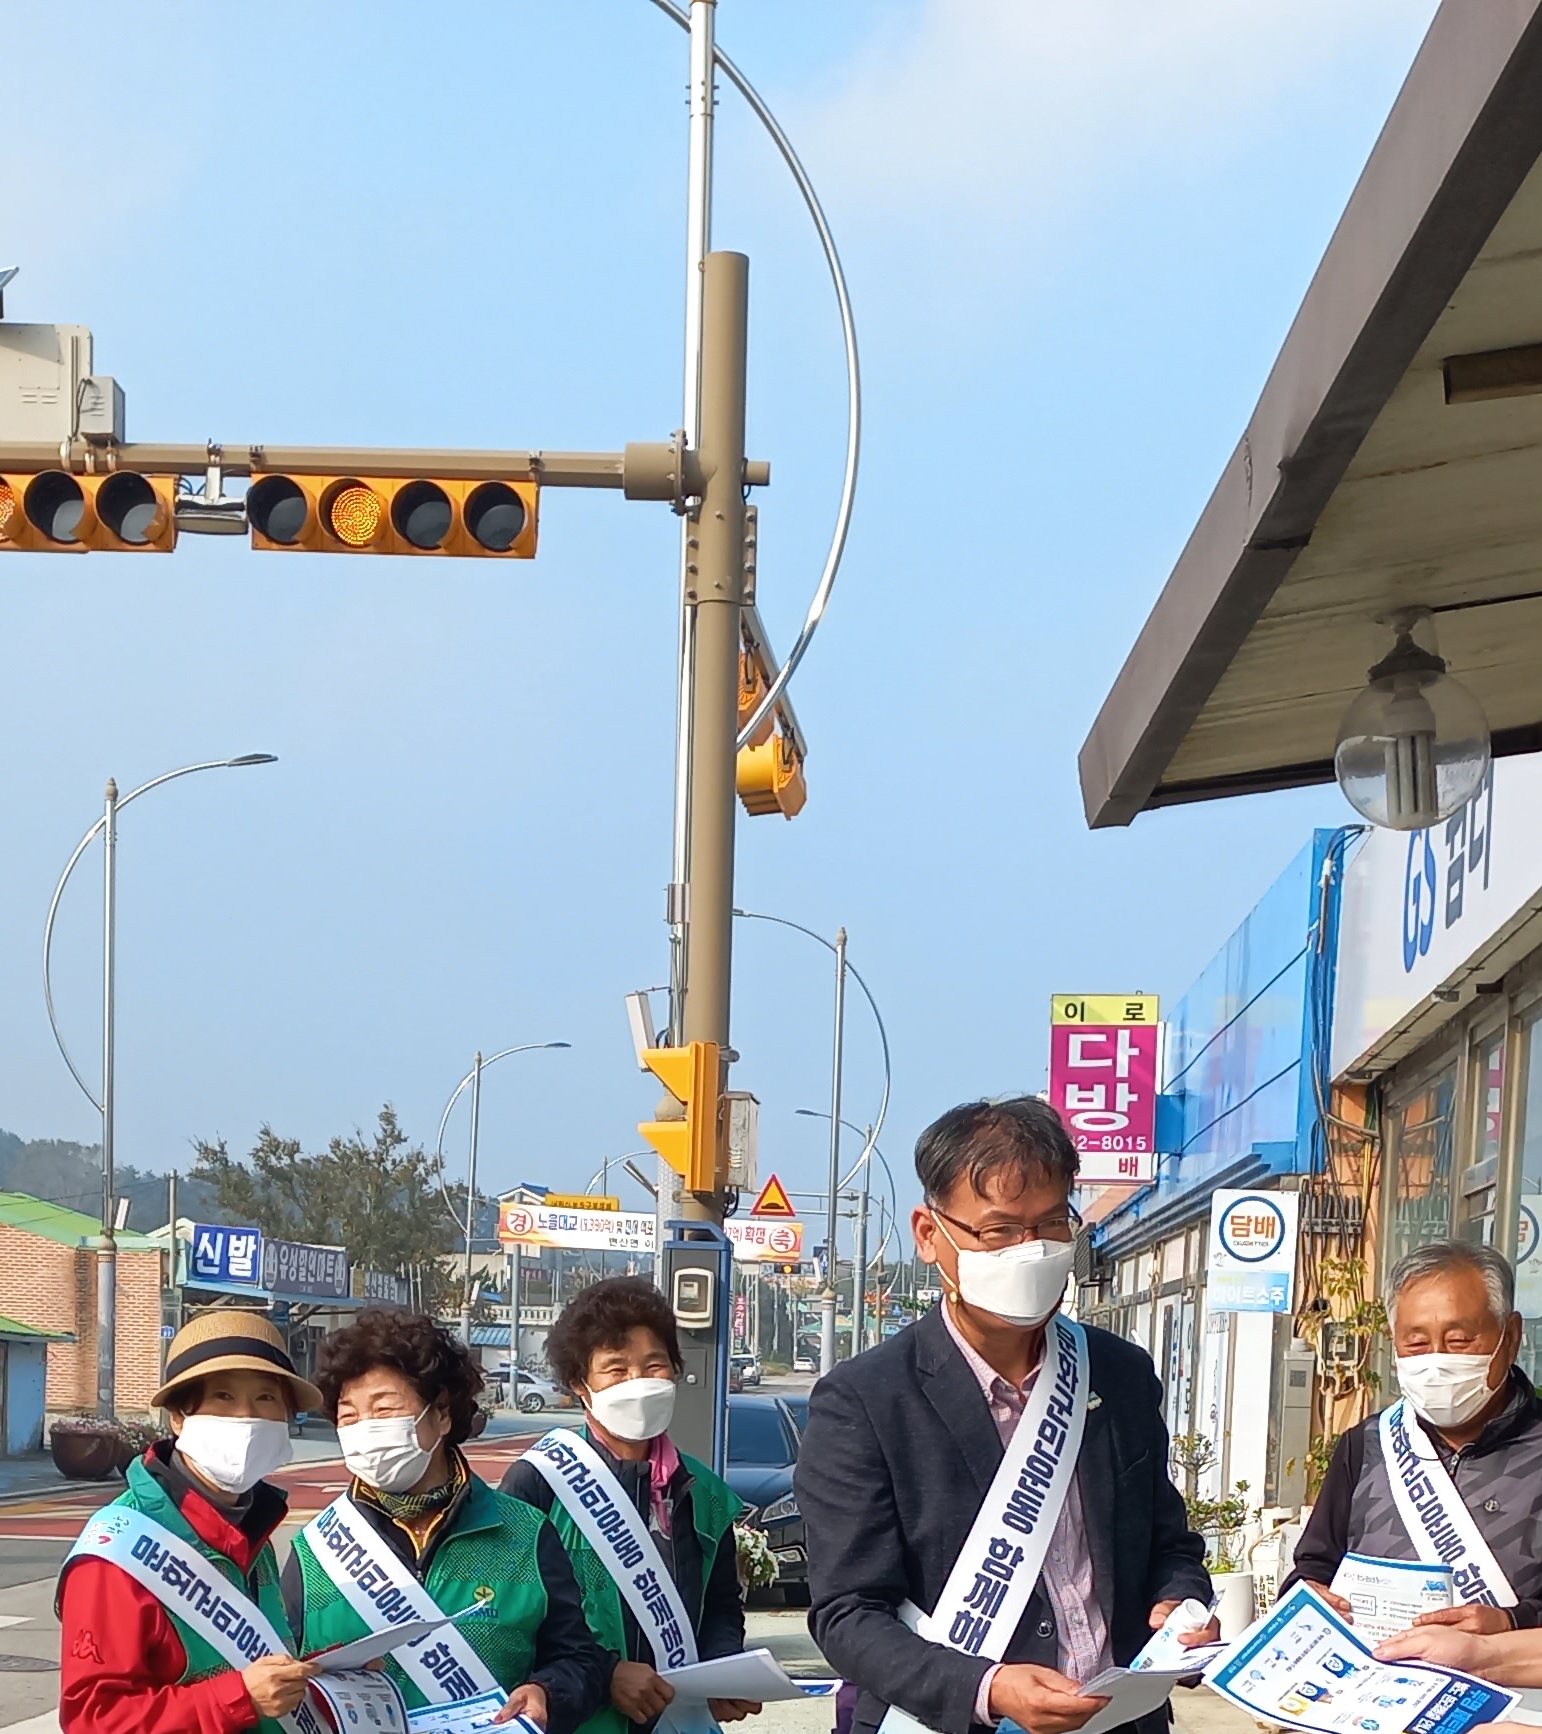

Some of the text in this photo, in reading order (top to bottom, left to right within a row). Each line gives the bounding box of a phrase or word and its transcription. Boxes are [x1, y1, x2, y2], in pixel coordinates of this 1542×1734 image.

[1402, 829, 1438, 973] GS
[1066, 1030, 1141, 1132] 다방
[509, 1211, 531, 1233] 경
[537, 1213, 579, 1233] 노을대교
[1230, 1214, 1277, 1240] 담배
[194, 1232, 257, 1277] 신발
[772, 1229, 793, 1251] 축
